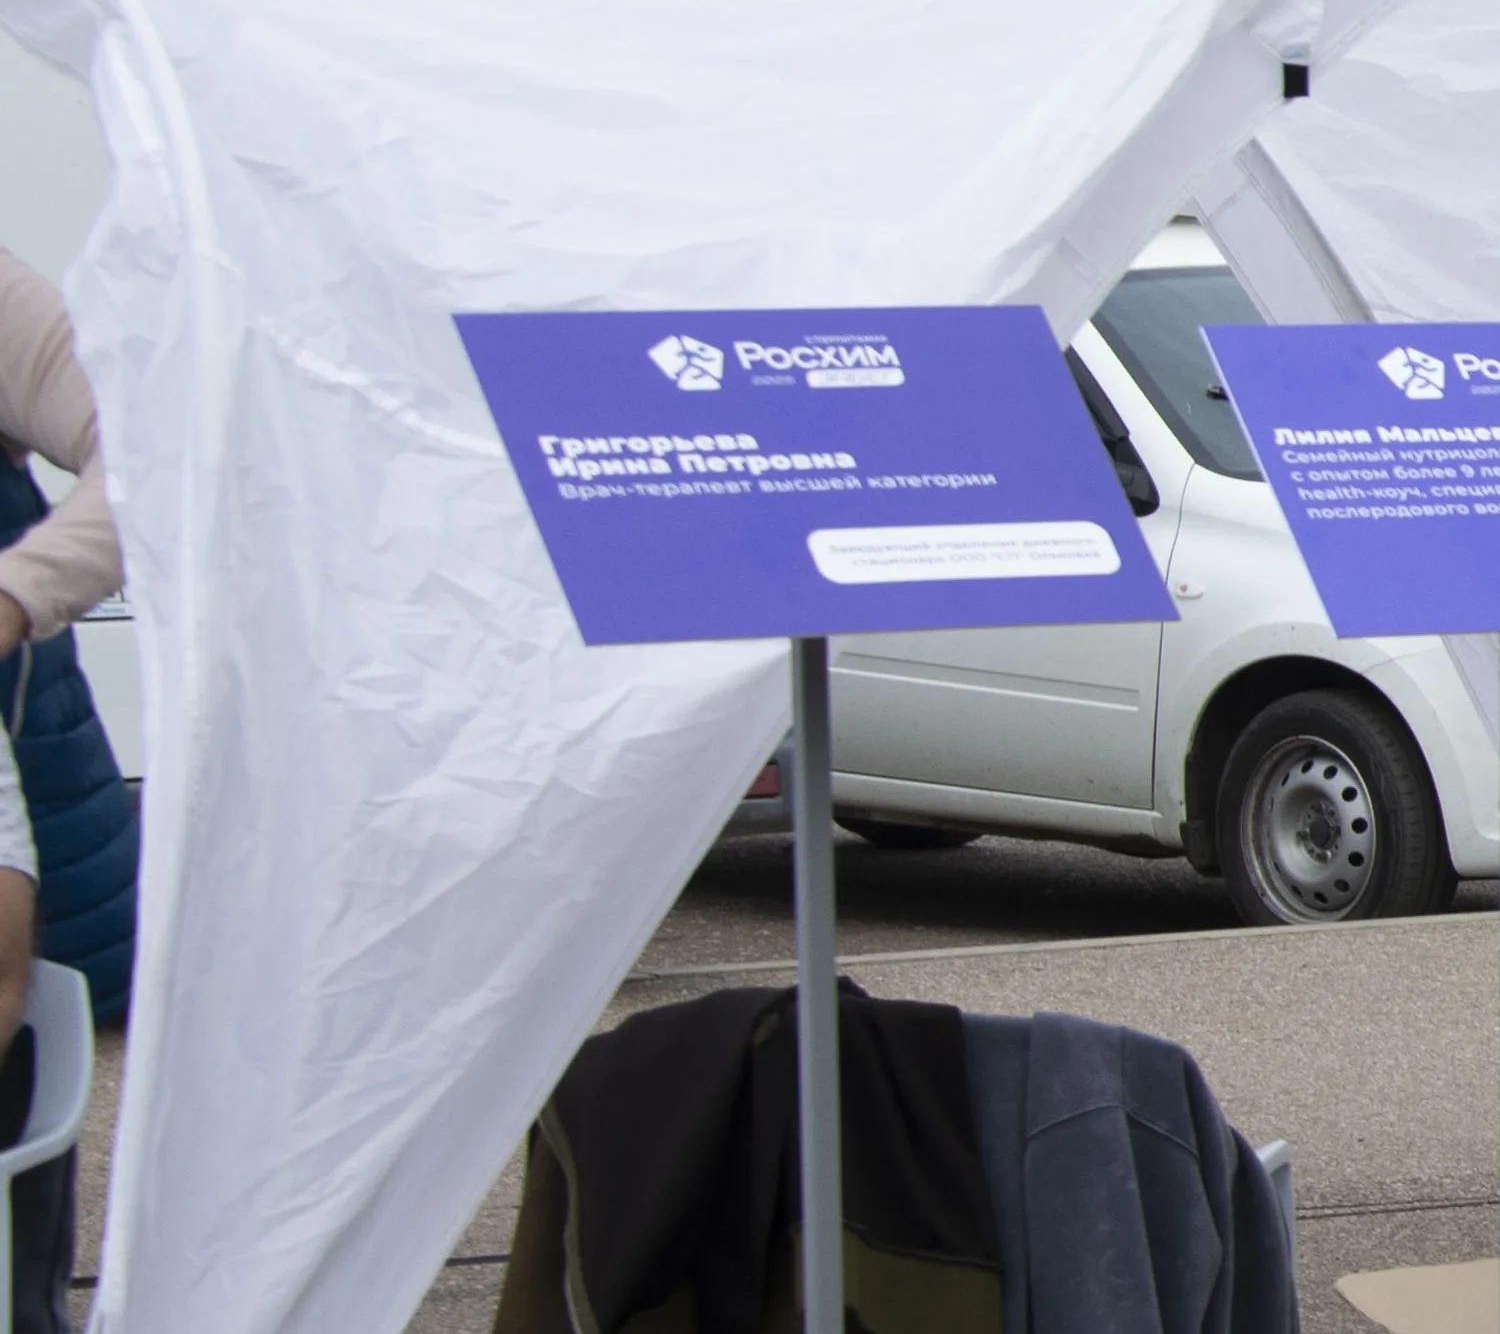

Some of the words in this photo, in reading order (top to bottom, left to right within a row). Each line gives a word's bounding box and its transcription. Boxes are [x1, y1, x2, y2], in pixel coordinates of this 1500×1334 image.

[537, 432, 758, 459] Григорьева
[1274, 426, 1373, 446] Лилия
[549, 454, 671, 478] Ирина
[680, 448, 856, 476] Петровна
[1282, 446, 1395, 466] Семейный
[1308, 466, 1388, 483] опытом
[1393, 463, 1456, 480] более
[1460, 463, 1474, 478] 9
[559, 478, 753, 502] Врач-терапевт
[759, 475, 863, 494] высшей
[867, 470, 998, 491] категории
